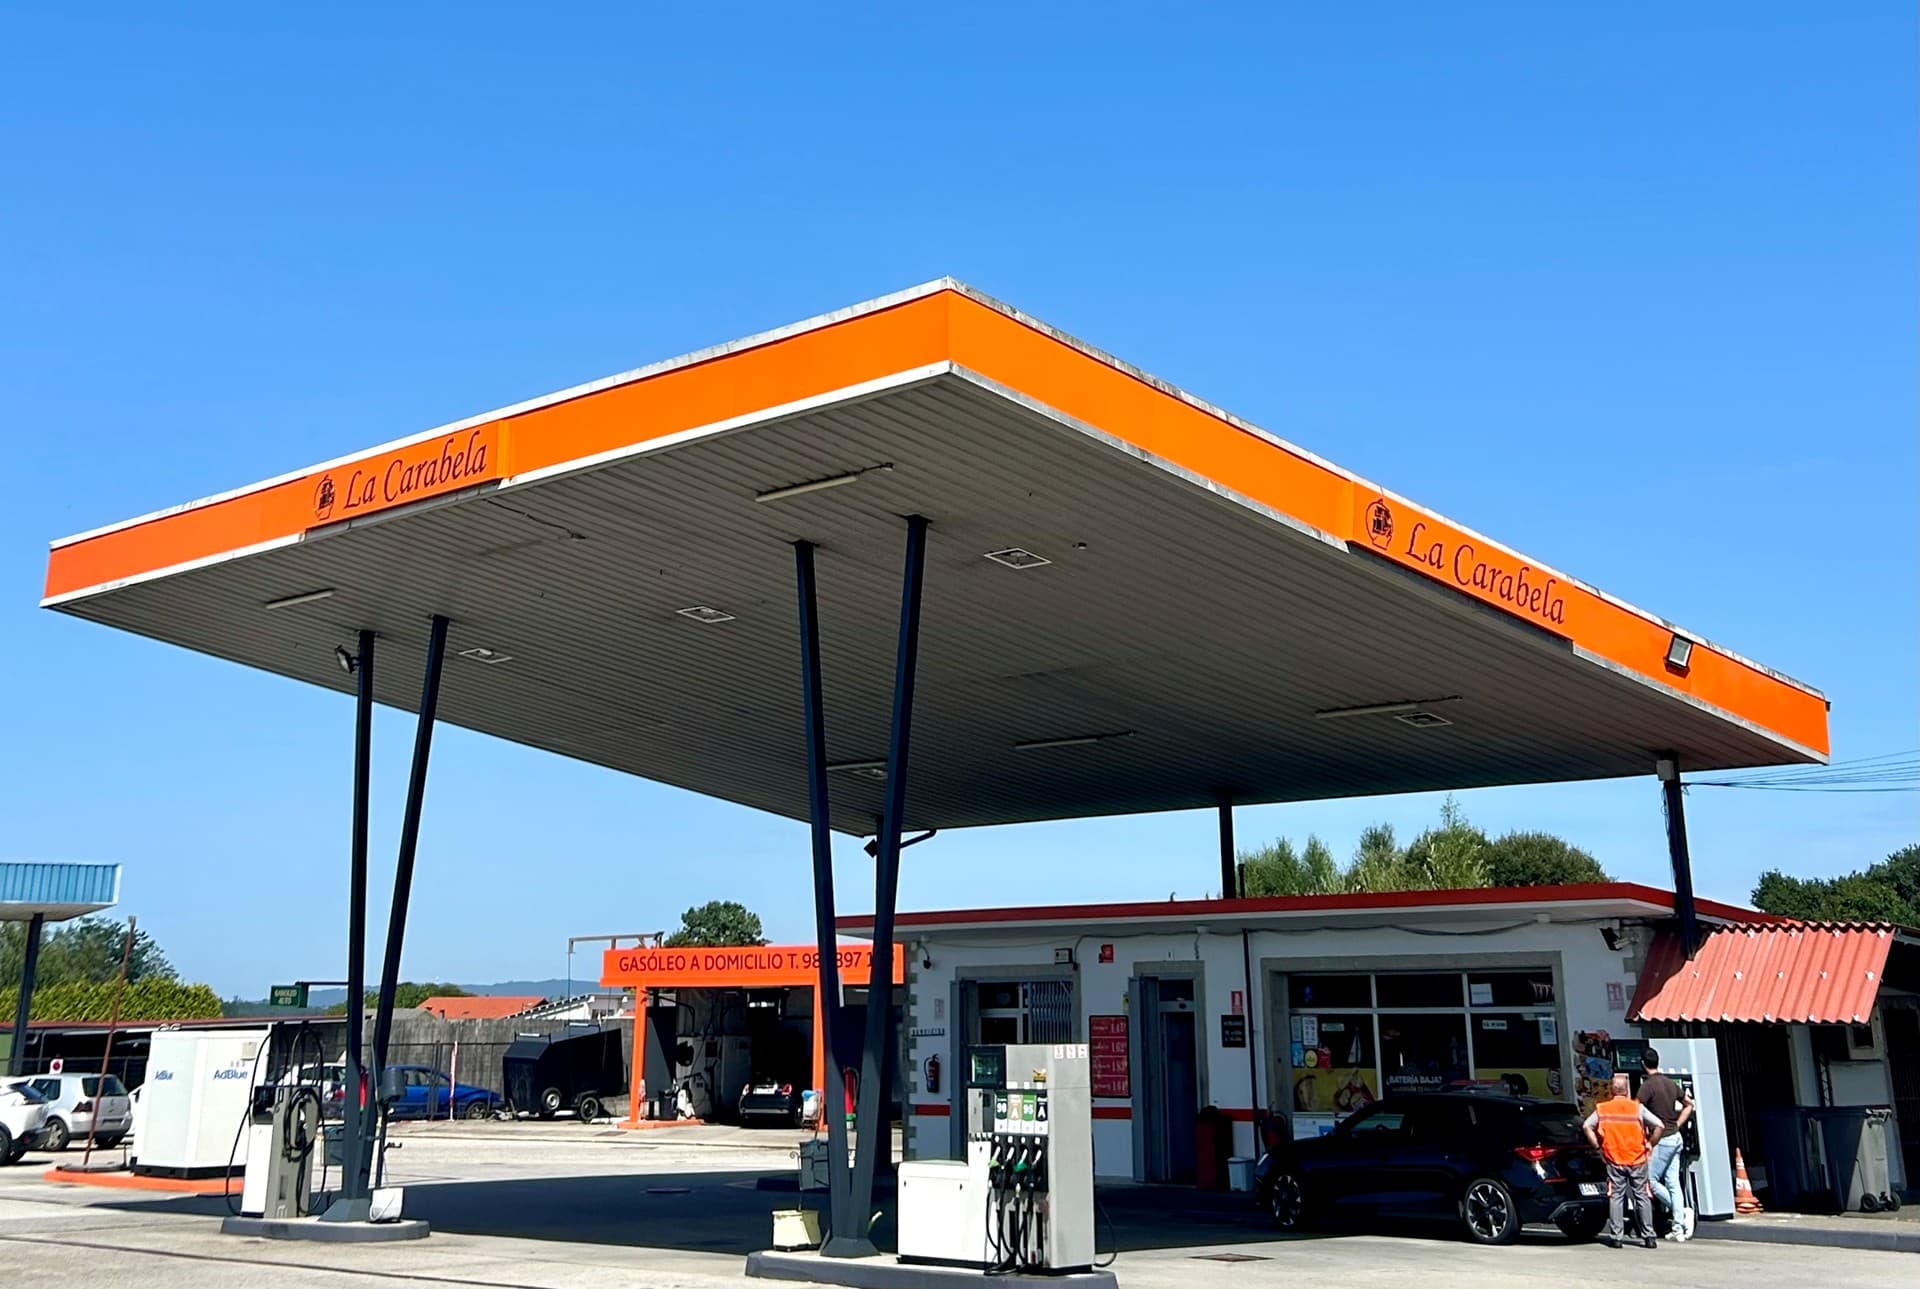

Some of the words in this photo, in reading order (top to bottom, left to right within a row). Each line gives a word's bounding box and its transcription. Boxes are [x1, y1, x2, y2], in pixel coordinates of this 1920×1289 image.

[344, 470, 377, 510] La
[383, 430, 488, 503] Carabela
[1405, 522, 1445, 570] La
[1454, 544, 1565, 625] Carabela
[618, 951, 686, 972] GASÓLEO
[690, 954, 700, 971] A
[704, 953, 782, 971] DOMICILIO
[787, 953, 799, 969] T.
[802, 952, 821, 969] 98
[213, 1069, 248, 1080] AdBlue
[1023, 1103, 1034, 1115] 95
[1037, 1105, 1046, 1118] A
